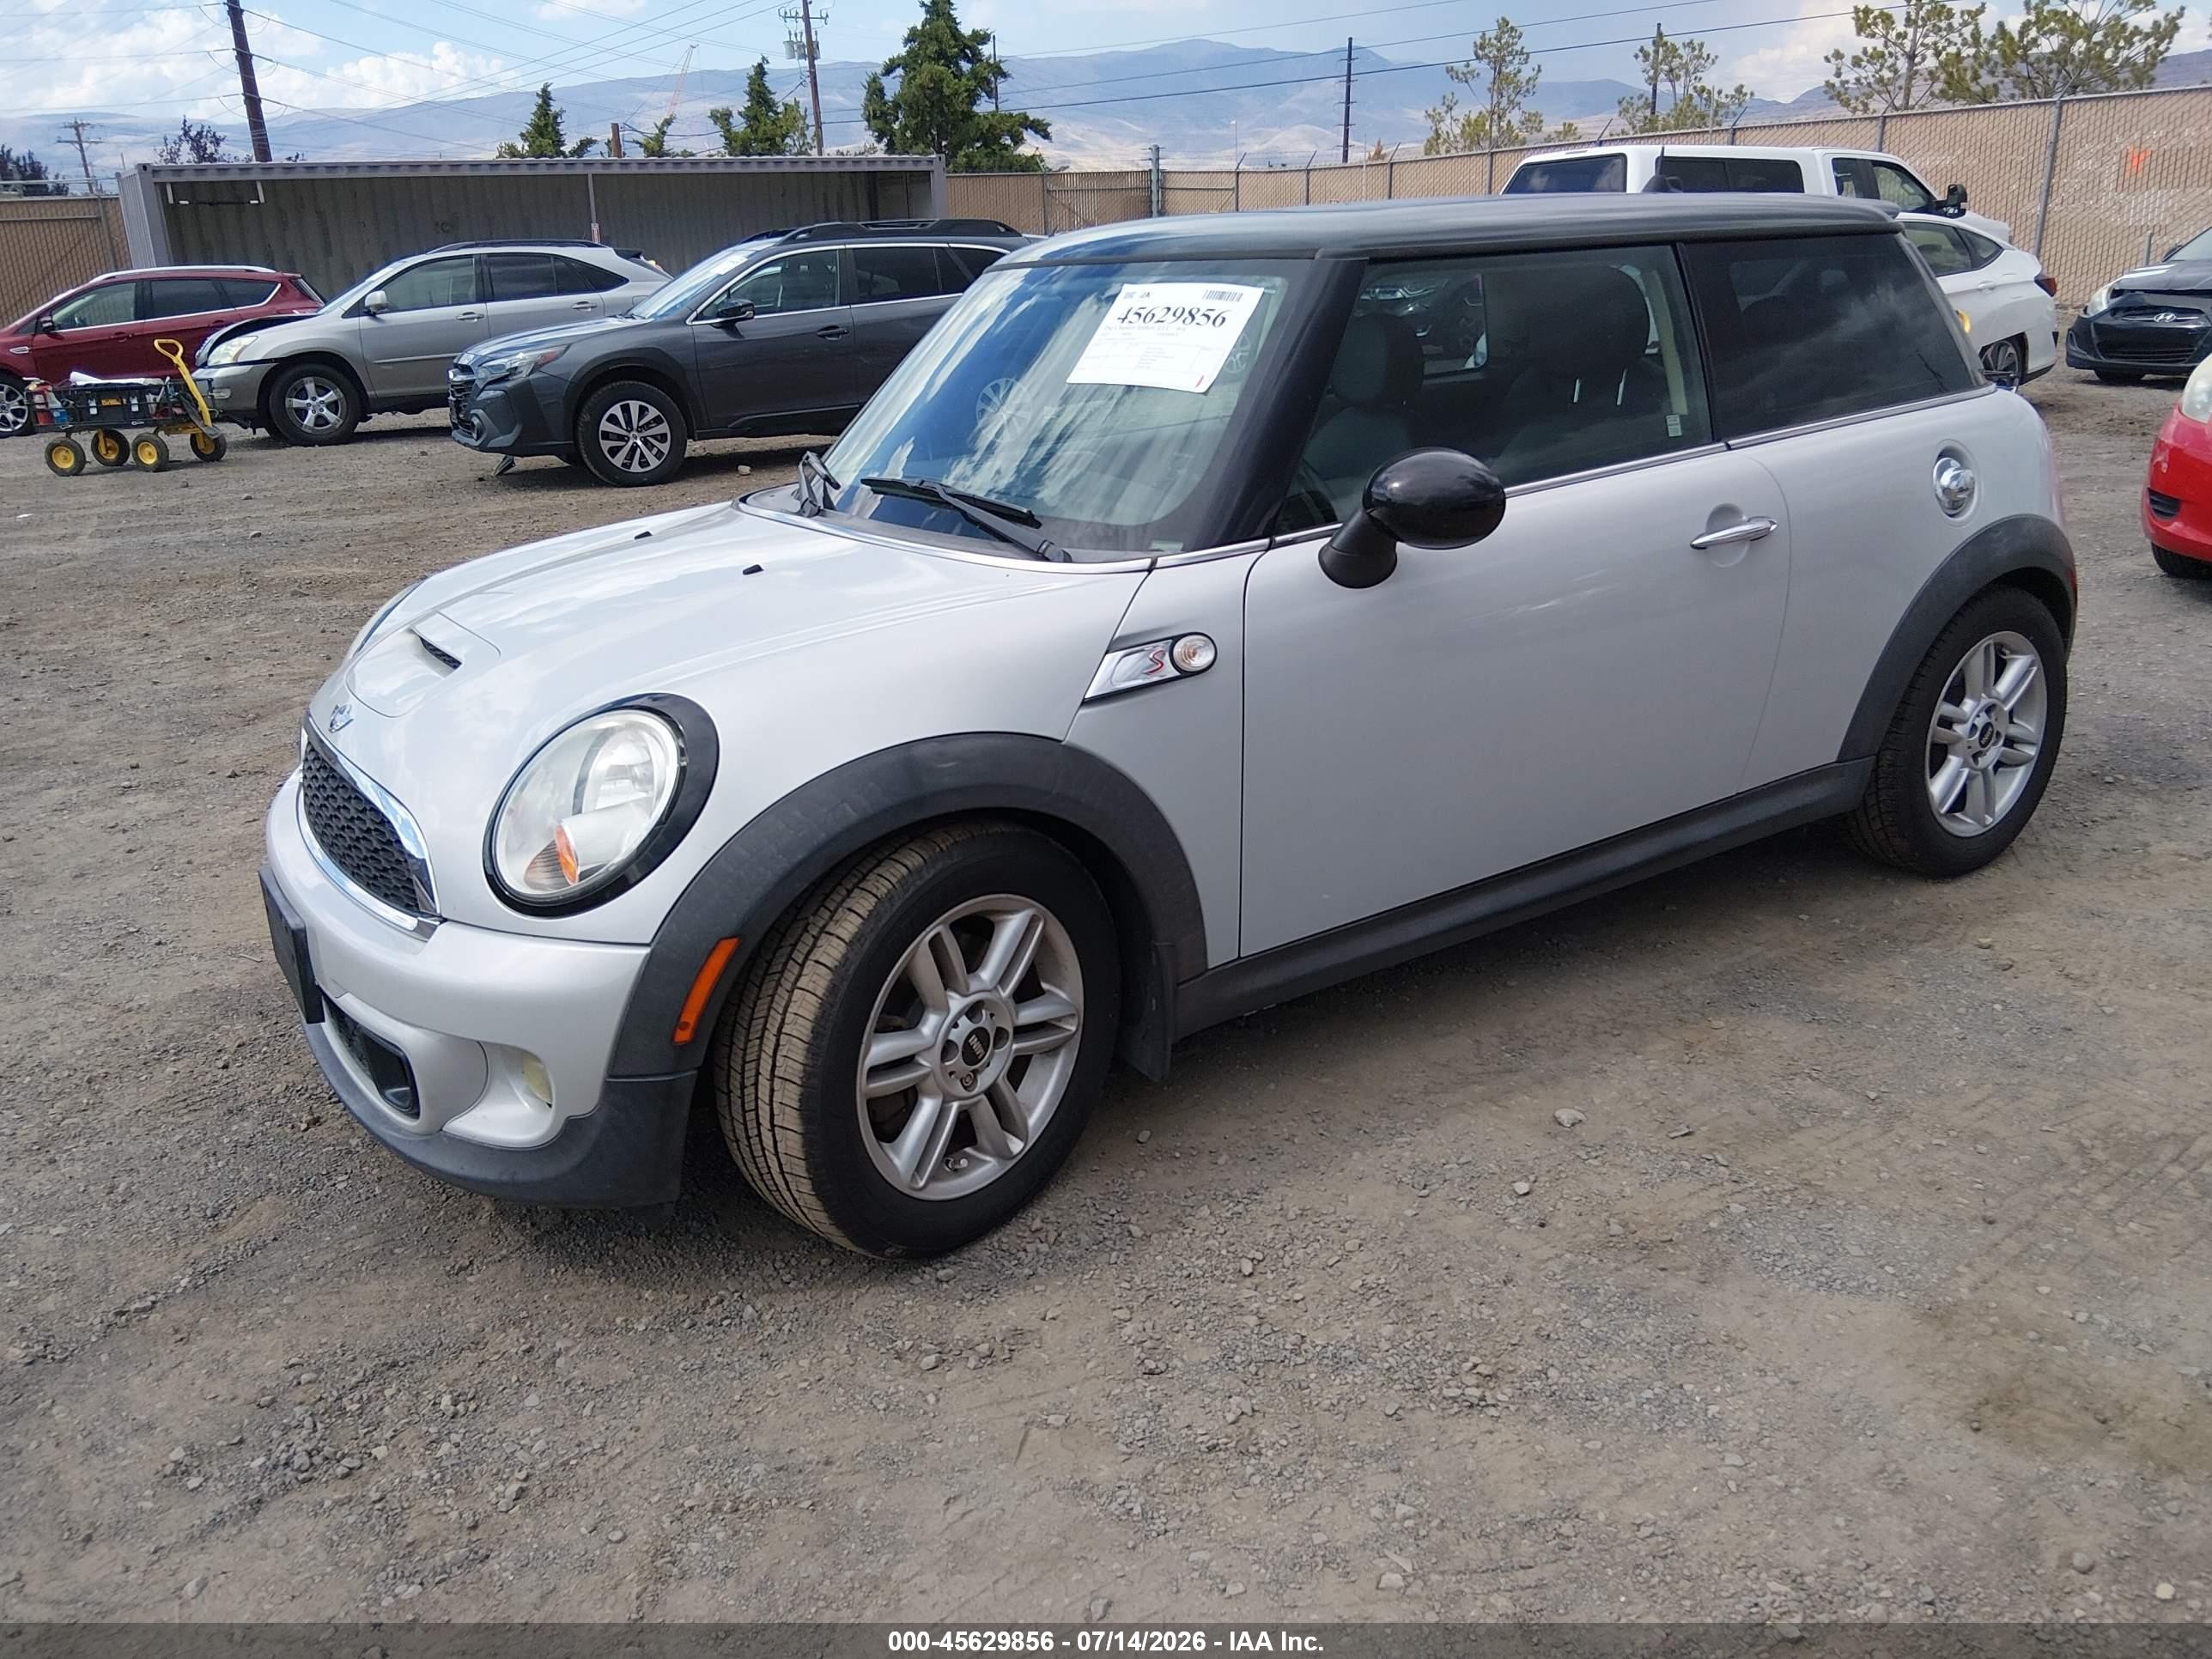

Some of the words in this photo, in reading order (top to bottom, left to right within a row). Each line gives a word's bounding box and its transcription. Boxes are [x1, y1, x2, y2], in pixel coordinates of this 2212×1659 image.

[1117, 306, 1231, 328] 45629856
[1144, 647, 1166, 675] S
[968, 1034, 985, 1059] MINI
